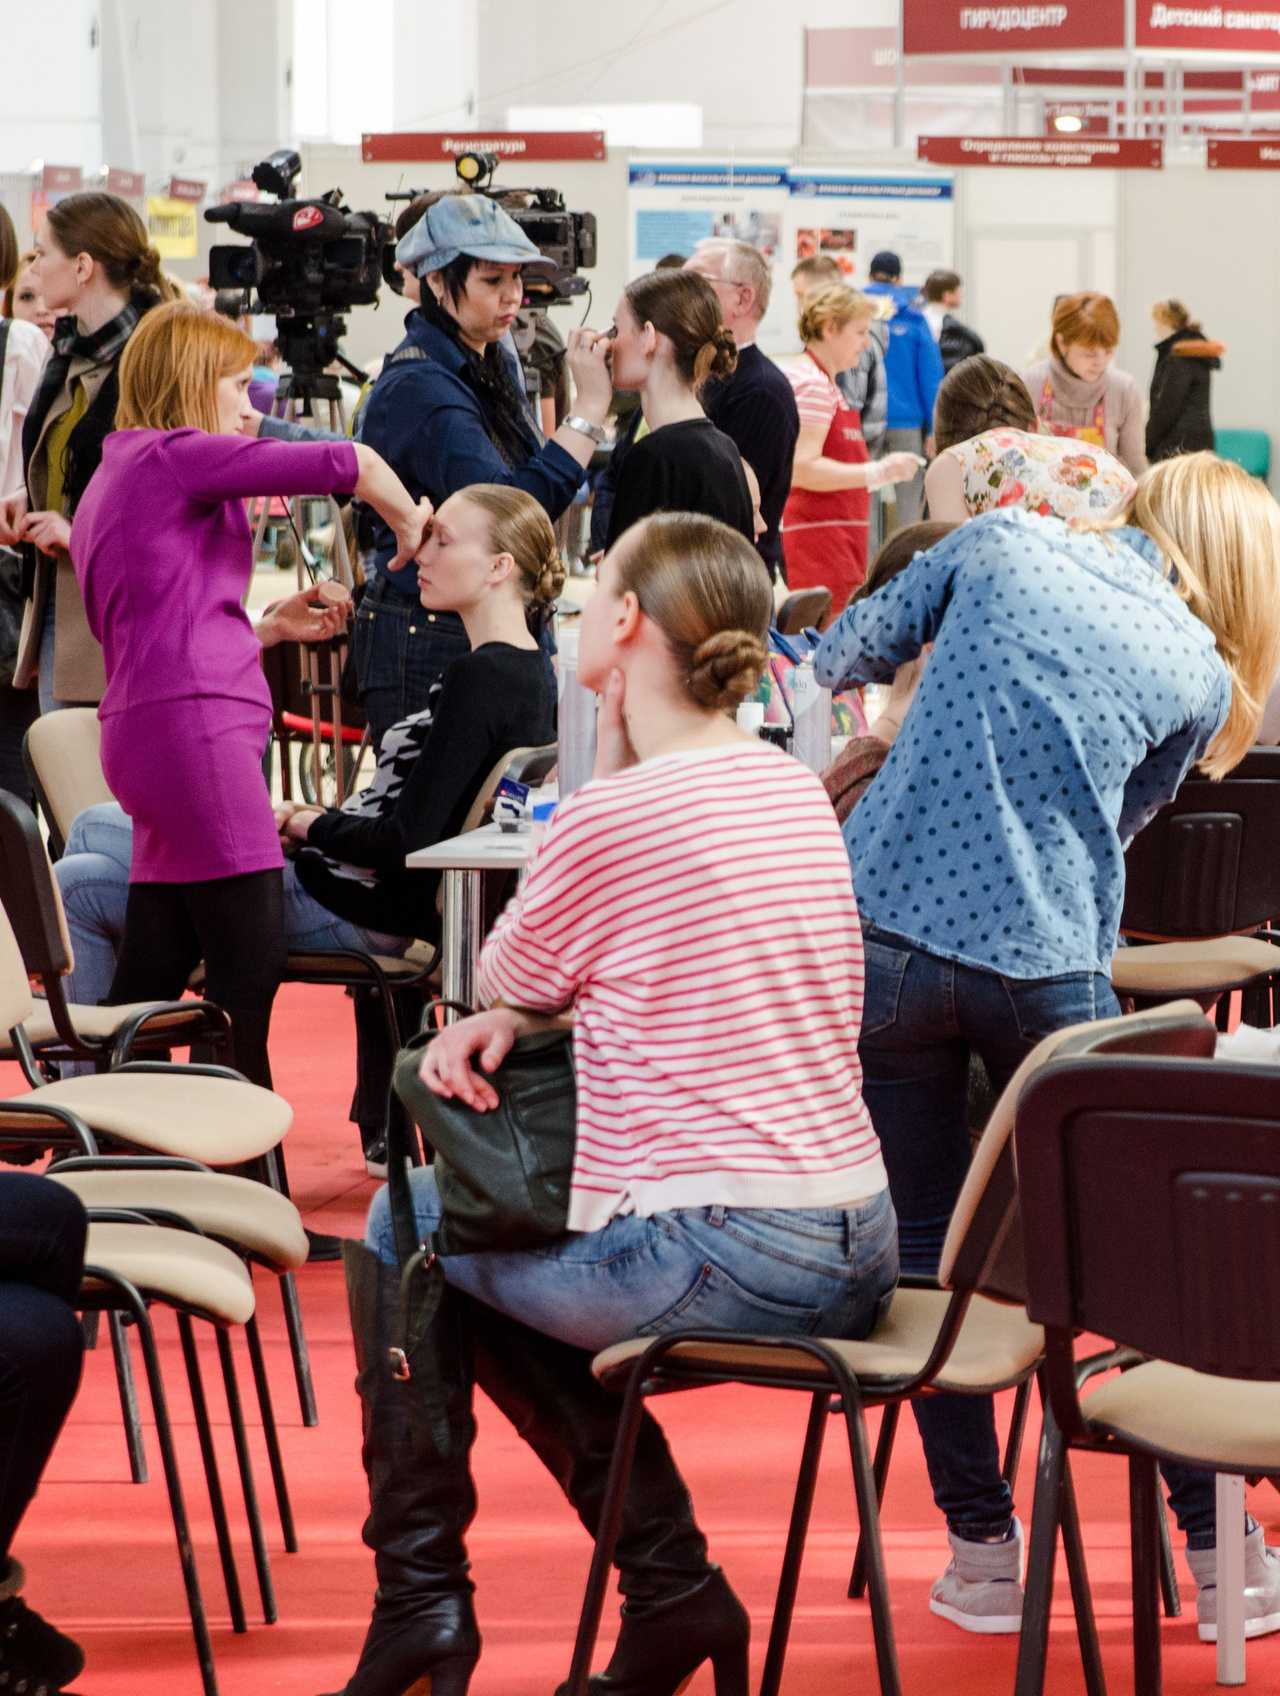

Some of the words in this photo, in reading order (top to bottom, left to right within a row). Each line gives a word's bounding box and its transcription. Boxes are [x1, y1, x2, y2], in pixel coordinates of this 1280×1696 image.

[960, 7, 1068, 30] ГИРУДОЦЕНТР
[1150, 4, 1223, 28] Детский
[442, 138, 526, 154] Регистратура
[960, 139, 1042, 154] Определение
